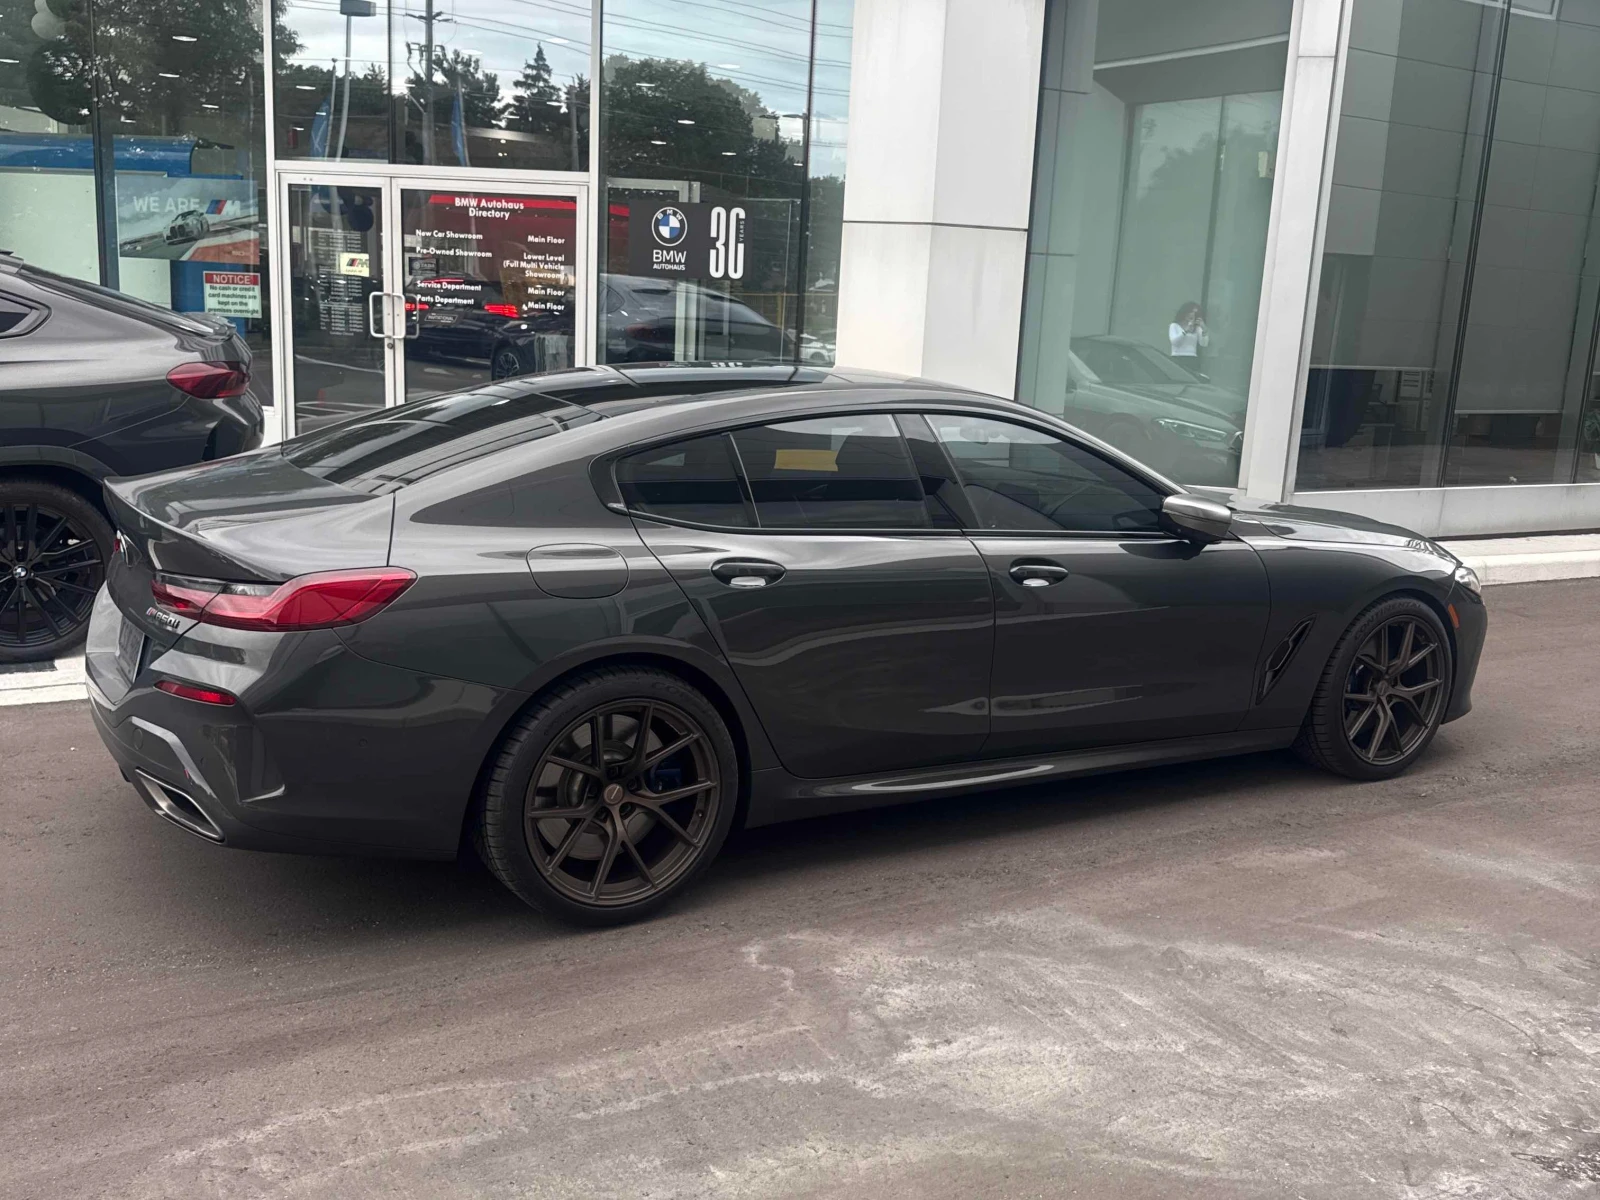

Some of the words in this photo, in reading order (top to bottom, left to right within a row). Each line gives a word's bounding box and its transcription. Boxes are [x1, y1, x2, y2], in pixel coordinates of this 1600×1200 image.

[133, 196, 160, 212] WE
[164, 198, 200, 213] ARE
[455, 197, 478, 207] BMW
[480, 200, 524, 210] Autohaus
[469, 208, 510, 220] Directory
[657, 208, 683, 220] BMW
[416, 229, 431, 237] New
[433, 230, 445, 238] Car
[446, 231, 483, 239] Showroom
[528, 235, 545, 243] Main
[546, 236, 565, 244] Floor
[416, 247, 454, 256] Pre-Owned
[455, 249, 492, 258] Showroom
[524, 253, 545, 261] Lower
[546, 253, 565, 262] Level
[653, 250, 687, 263] BMW
[503, 260, 519, 269] (Full
[520, 261, 538, 269] Multi
[539, 262, 565, 270] Vehicle
[213, 274, 251, 284] NOTICE
[525, 270, 565, 280] Showroom)
[417, 280, 441, 289] Service
[442, 282, 482, 292] Department
[528, 287, 545, 295] Main
[546, 288, 565, 296] Floor
[416, 294, 433, 303] Parts
[435, 296, 475, 305] Department
[528, 302, 545, 310] Main
[546, 302, 565, 311] Floor
[233, 308, 259, 316] overnight
